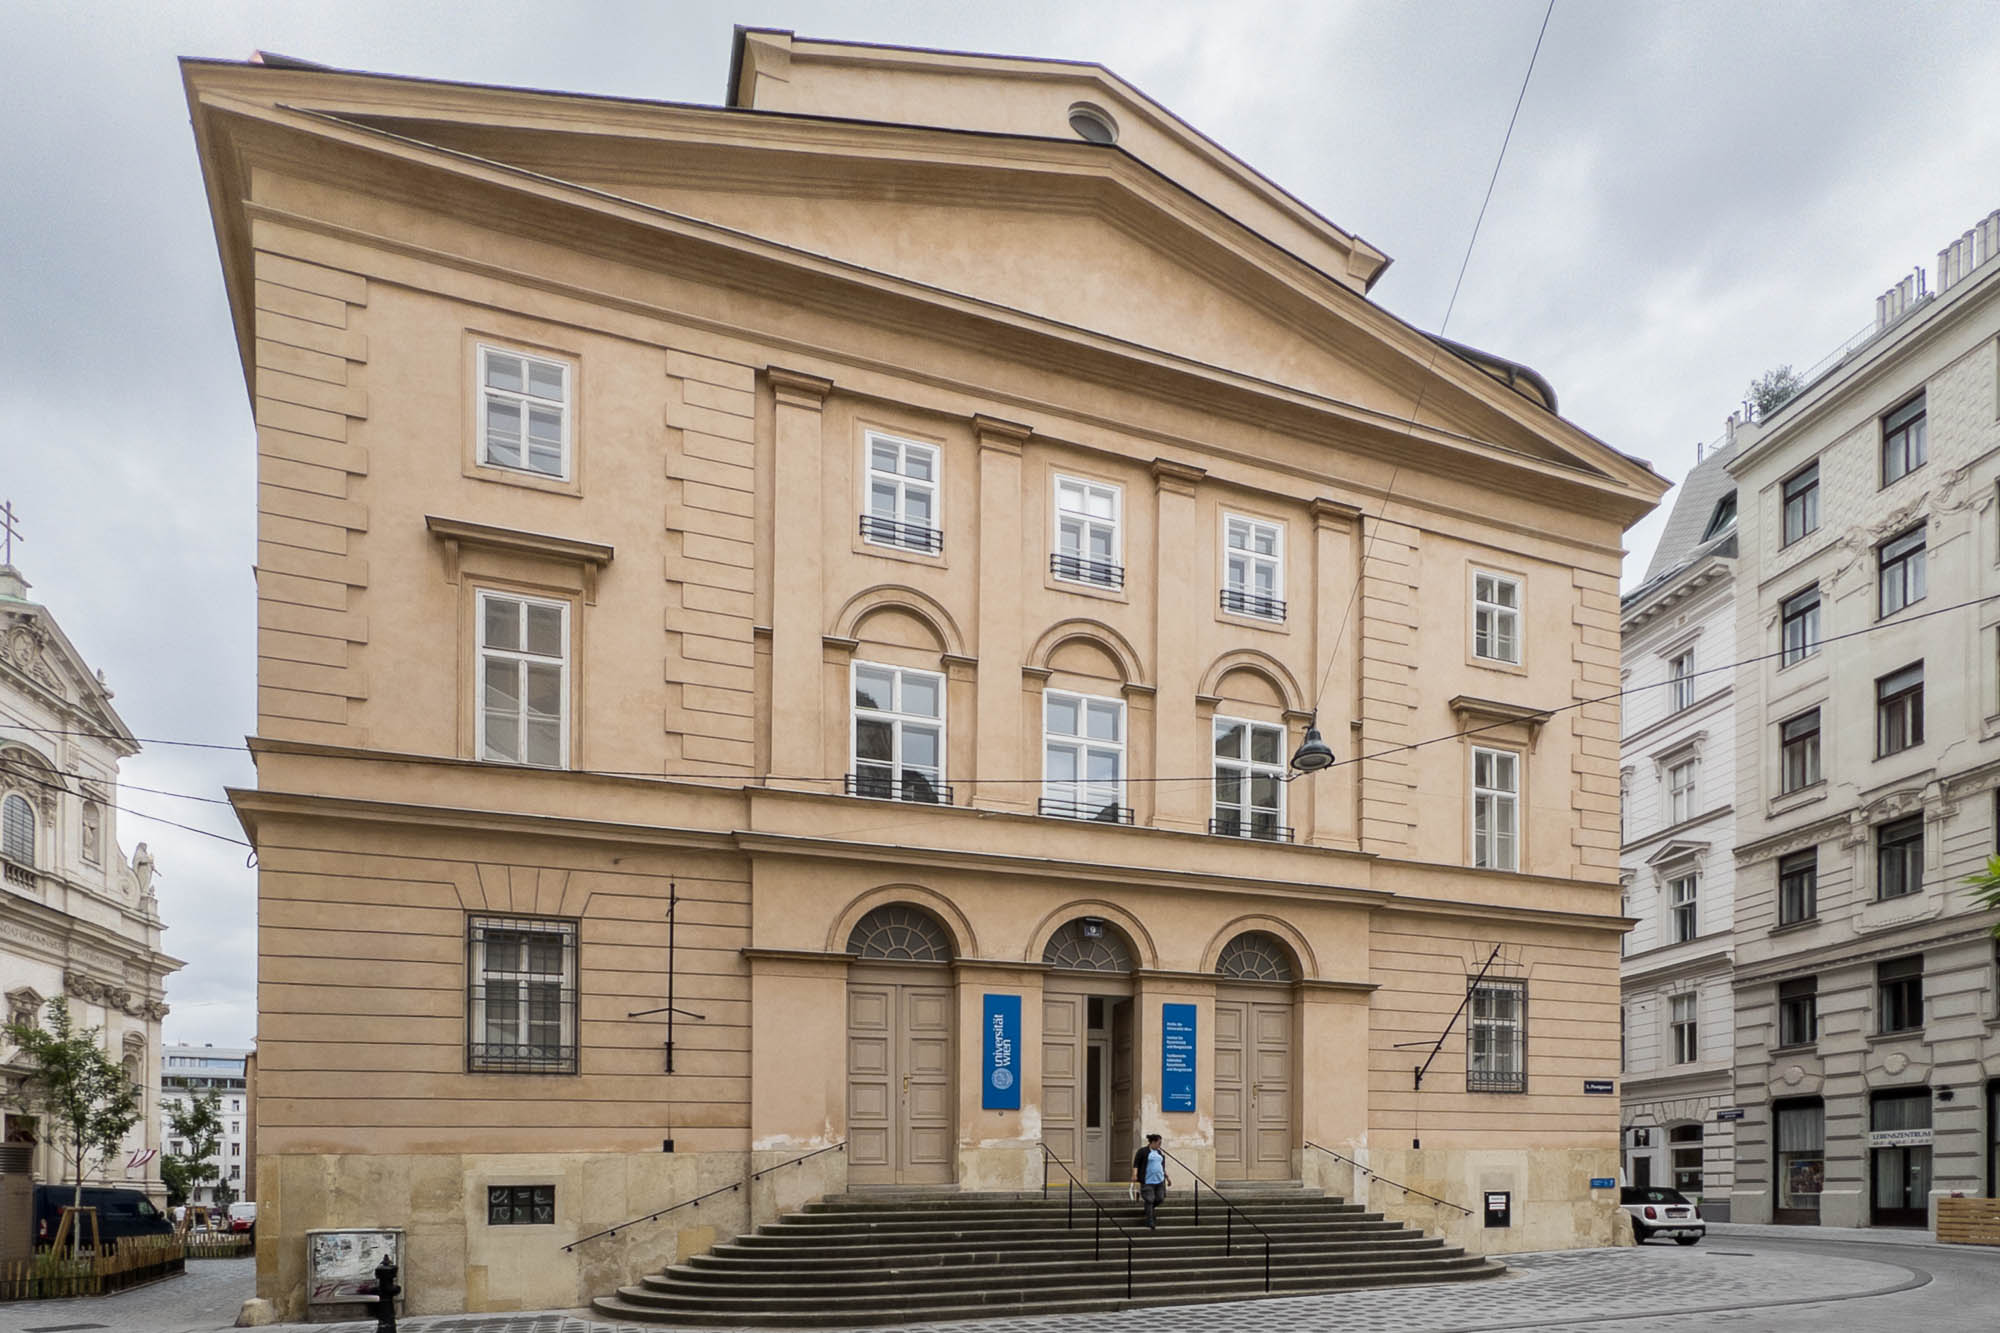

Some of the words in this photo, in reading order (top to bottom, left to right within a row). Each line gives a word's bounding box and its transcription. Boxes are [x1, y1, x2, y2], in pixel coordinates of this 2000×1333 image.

[992, 1014, 1004, 1067] universität
[1003, 1039, 1012, 1066] wien
[1872, 1131, 1931, 1140] LEBENSZENTRUM
